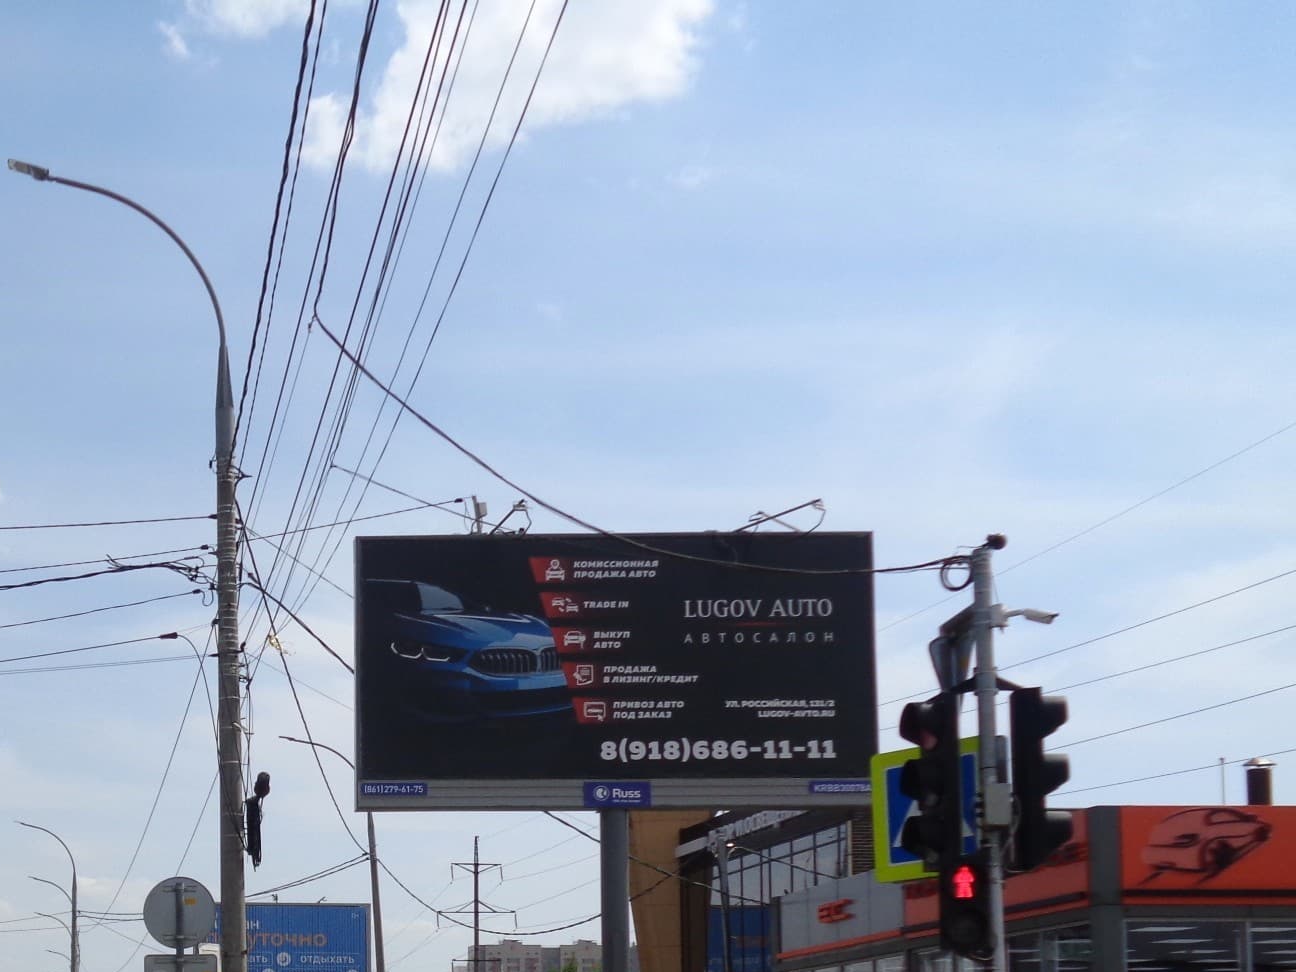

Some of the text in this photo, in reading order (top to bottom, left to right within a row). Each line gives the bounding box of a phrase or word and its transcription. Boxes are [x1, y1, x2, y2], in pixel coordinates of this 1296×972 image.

[573, 560, 659, 568] КОМИССИОННАЯ
[573, 570, 657, 579] ПРОДАЖА АВТО
[583, 600, 630, 609] TRADE IN
[683, 598, 833, 618] LUGOV AUTO
[593, 631, 631, 639] ВЫКУП
[683, 631, 834, 644] АВТОСАЛОН
[593, 641, 622, 649] АВТО
[603, 665, 657, 674] ПРОДАЖА
[611, 675, 699, 684] ЛИЗИНГ/КРЕДИТ
[613, 701, 685, 709] ПРИВОЗ АВТО
[613, 711, 672, 719] ПОД ЗАКАЗ
[600, 737, 837, 762] 8(918)686-11-11
[612, 788, 641, 798] Russ
[300, 954, 355, 964] отдыхать
